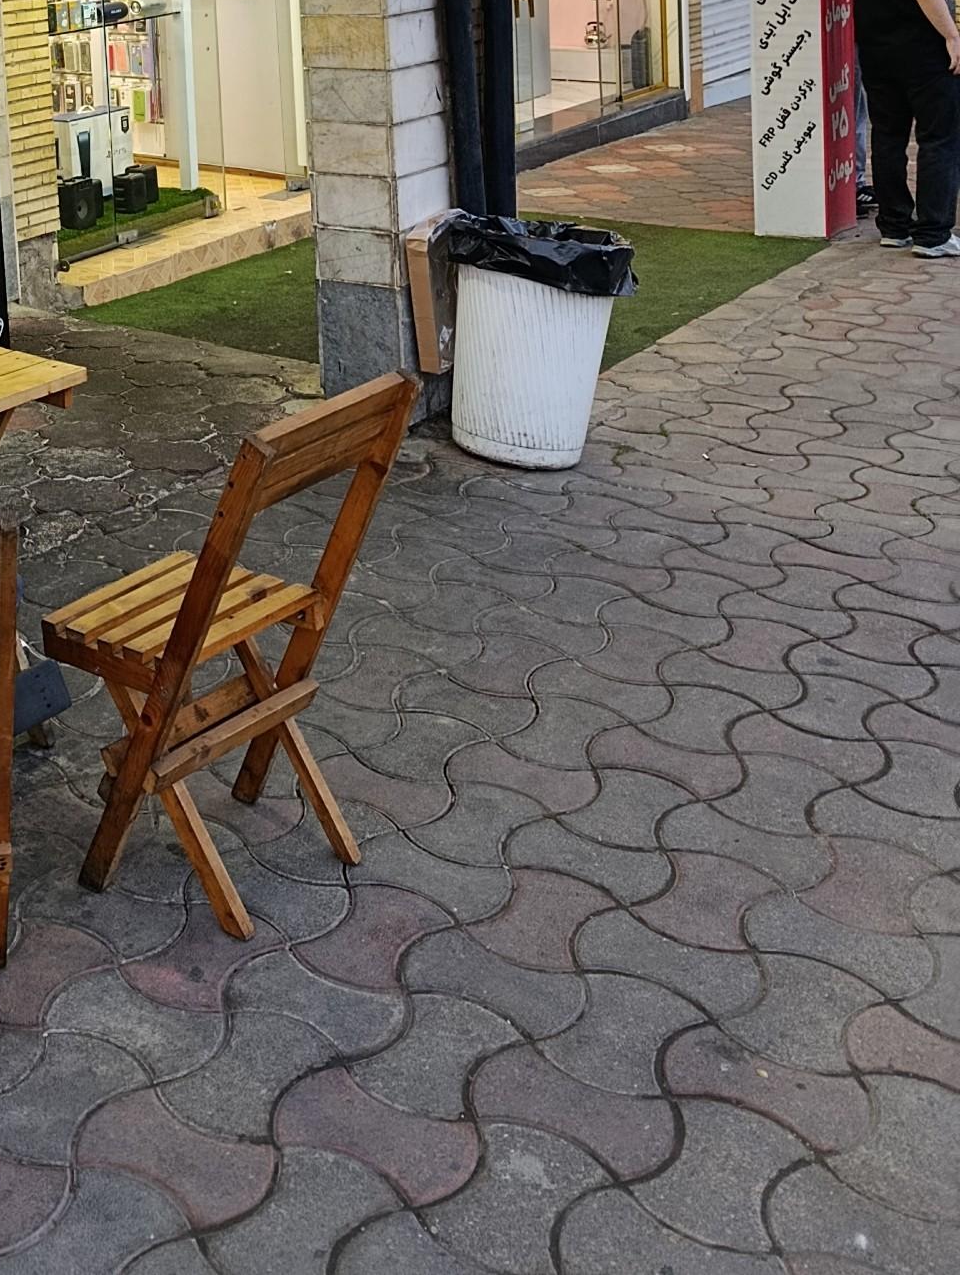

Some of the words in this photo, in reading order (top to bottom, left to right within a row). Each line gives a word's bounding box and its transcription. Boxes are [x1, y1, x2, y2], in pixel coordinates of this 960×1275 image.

[774, 3, 791, 26] اپل
[759, 21, 777, 50] آیدی
[782, 29, 812, 67] رجیستر
[761, 62, 783, 96] گوشی
[829, 61, 850, 103] گلس
[775, 107, 791, 130] قفل
[831, 106, 849, 142] ۲۵
[759, 127, 776, 148] FRP
[793, 121, 817, 155] تعویض
[778, 150, 793, 174] گلس
[828, 152, 854, 192] تومان
[761, 171, 778, 191] LCD
